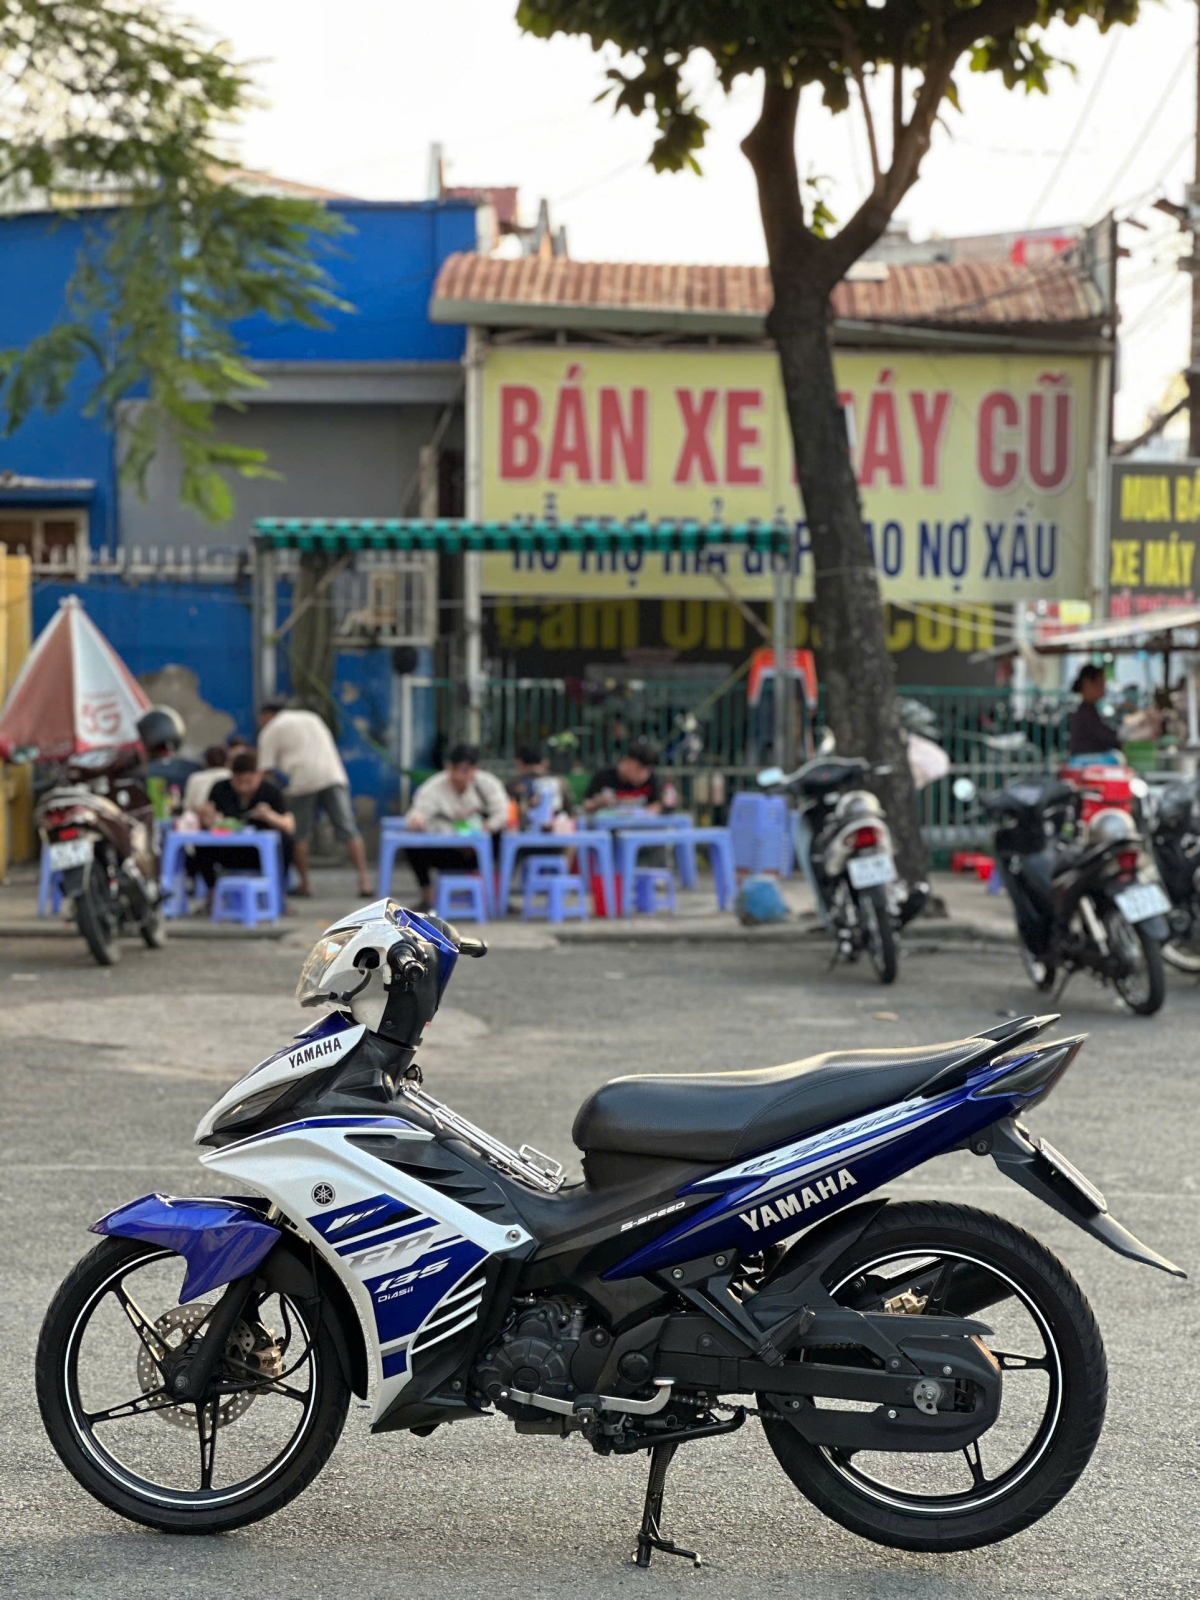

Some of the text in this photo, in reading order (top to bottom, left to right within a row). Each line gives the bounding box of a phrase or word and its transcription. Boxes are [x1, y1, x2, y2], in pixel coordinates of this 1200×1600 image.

[500, 364, 1072, 490] BÁN XE ÁY CŨ
[918, 514, 970, 593] NỢ
[1109, 540, 1142, 588] XE
[288, 1037, 342, 1070] YAMAHA
[739, 1167, 858, 1232] YAMAHA
[373, 1257, 452, 1294] 135
